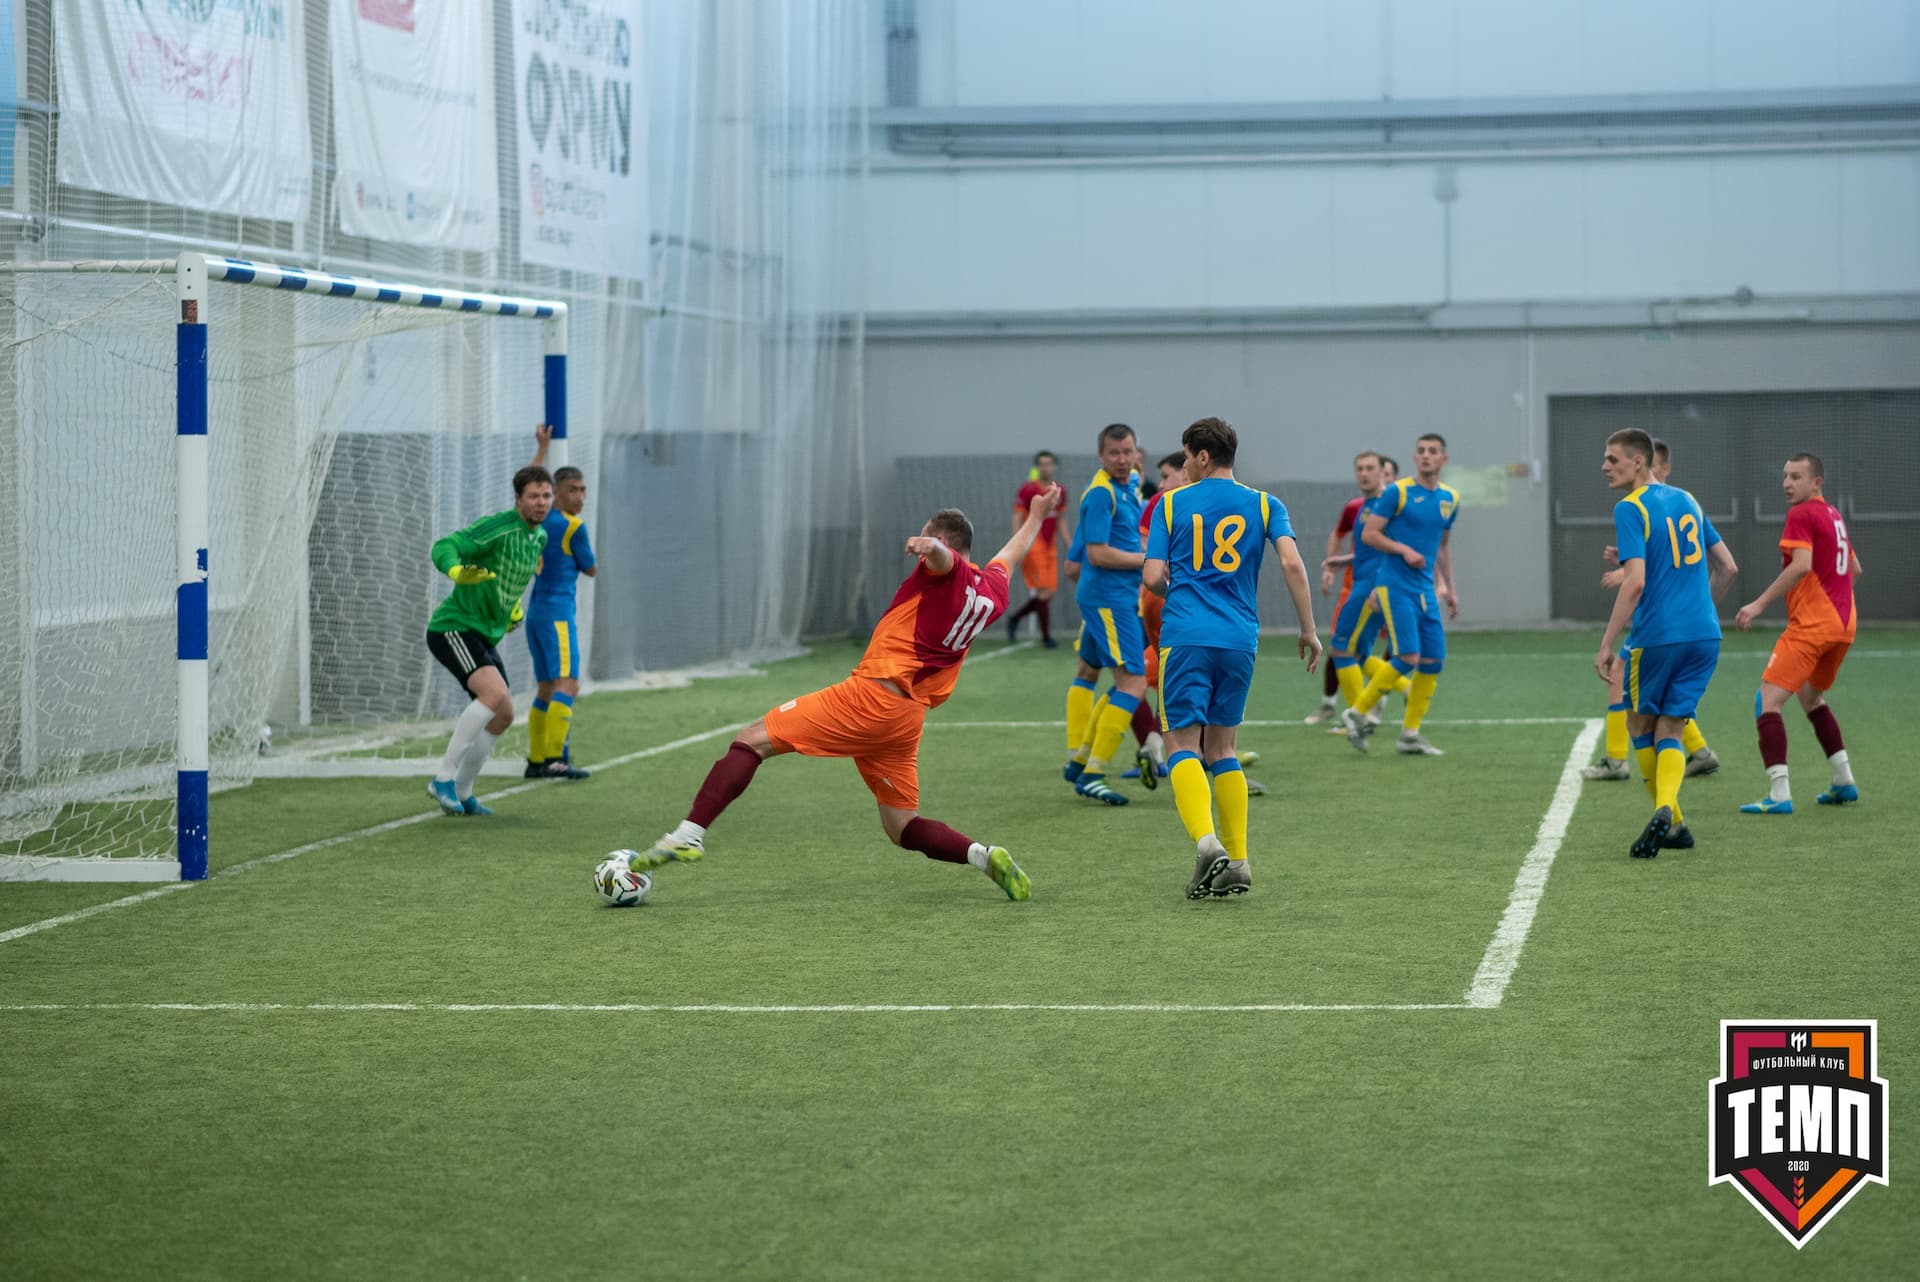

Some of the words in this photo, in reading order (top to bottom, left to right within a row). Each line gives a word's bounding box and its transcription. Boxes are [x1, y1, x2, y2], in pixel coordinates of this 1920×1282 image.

[1192, 513, 1246, 573] 18
[1665, 513, 1703, 569] 13
[1834, 519, 1849, 577] 5
[942, 585, 994, 652] 10
